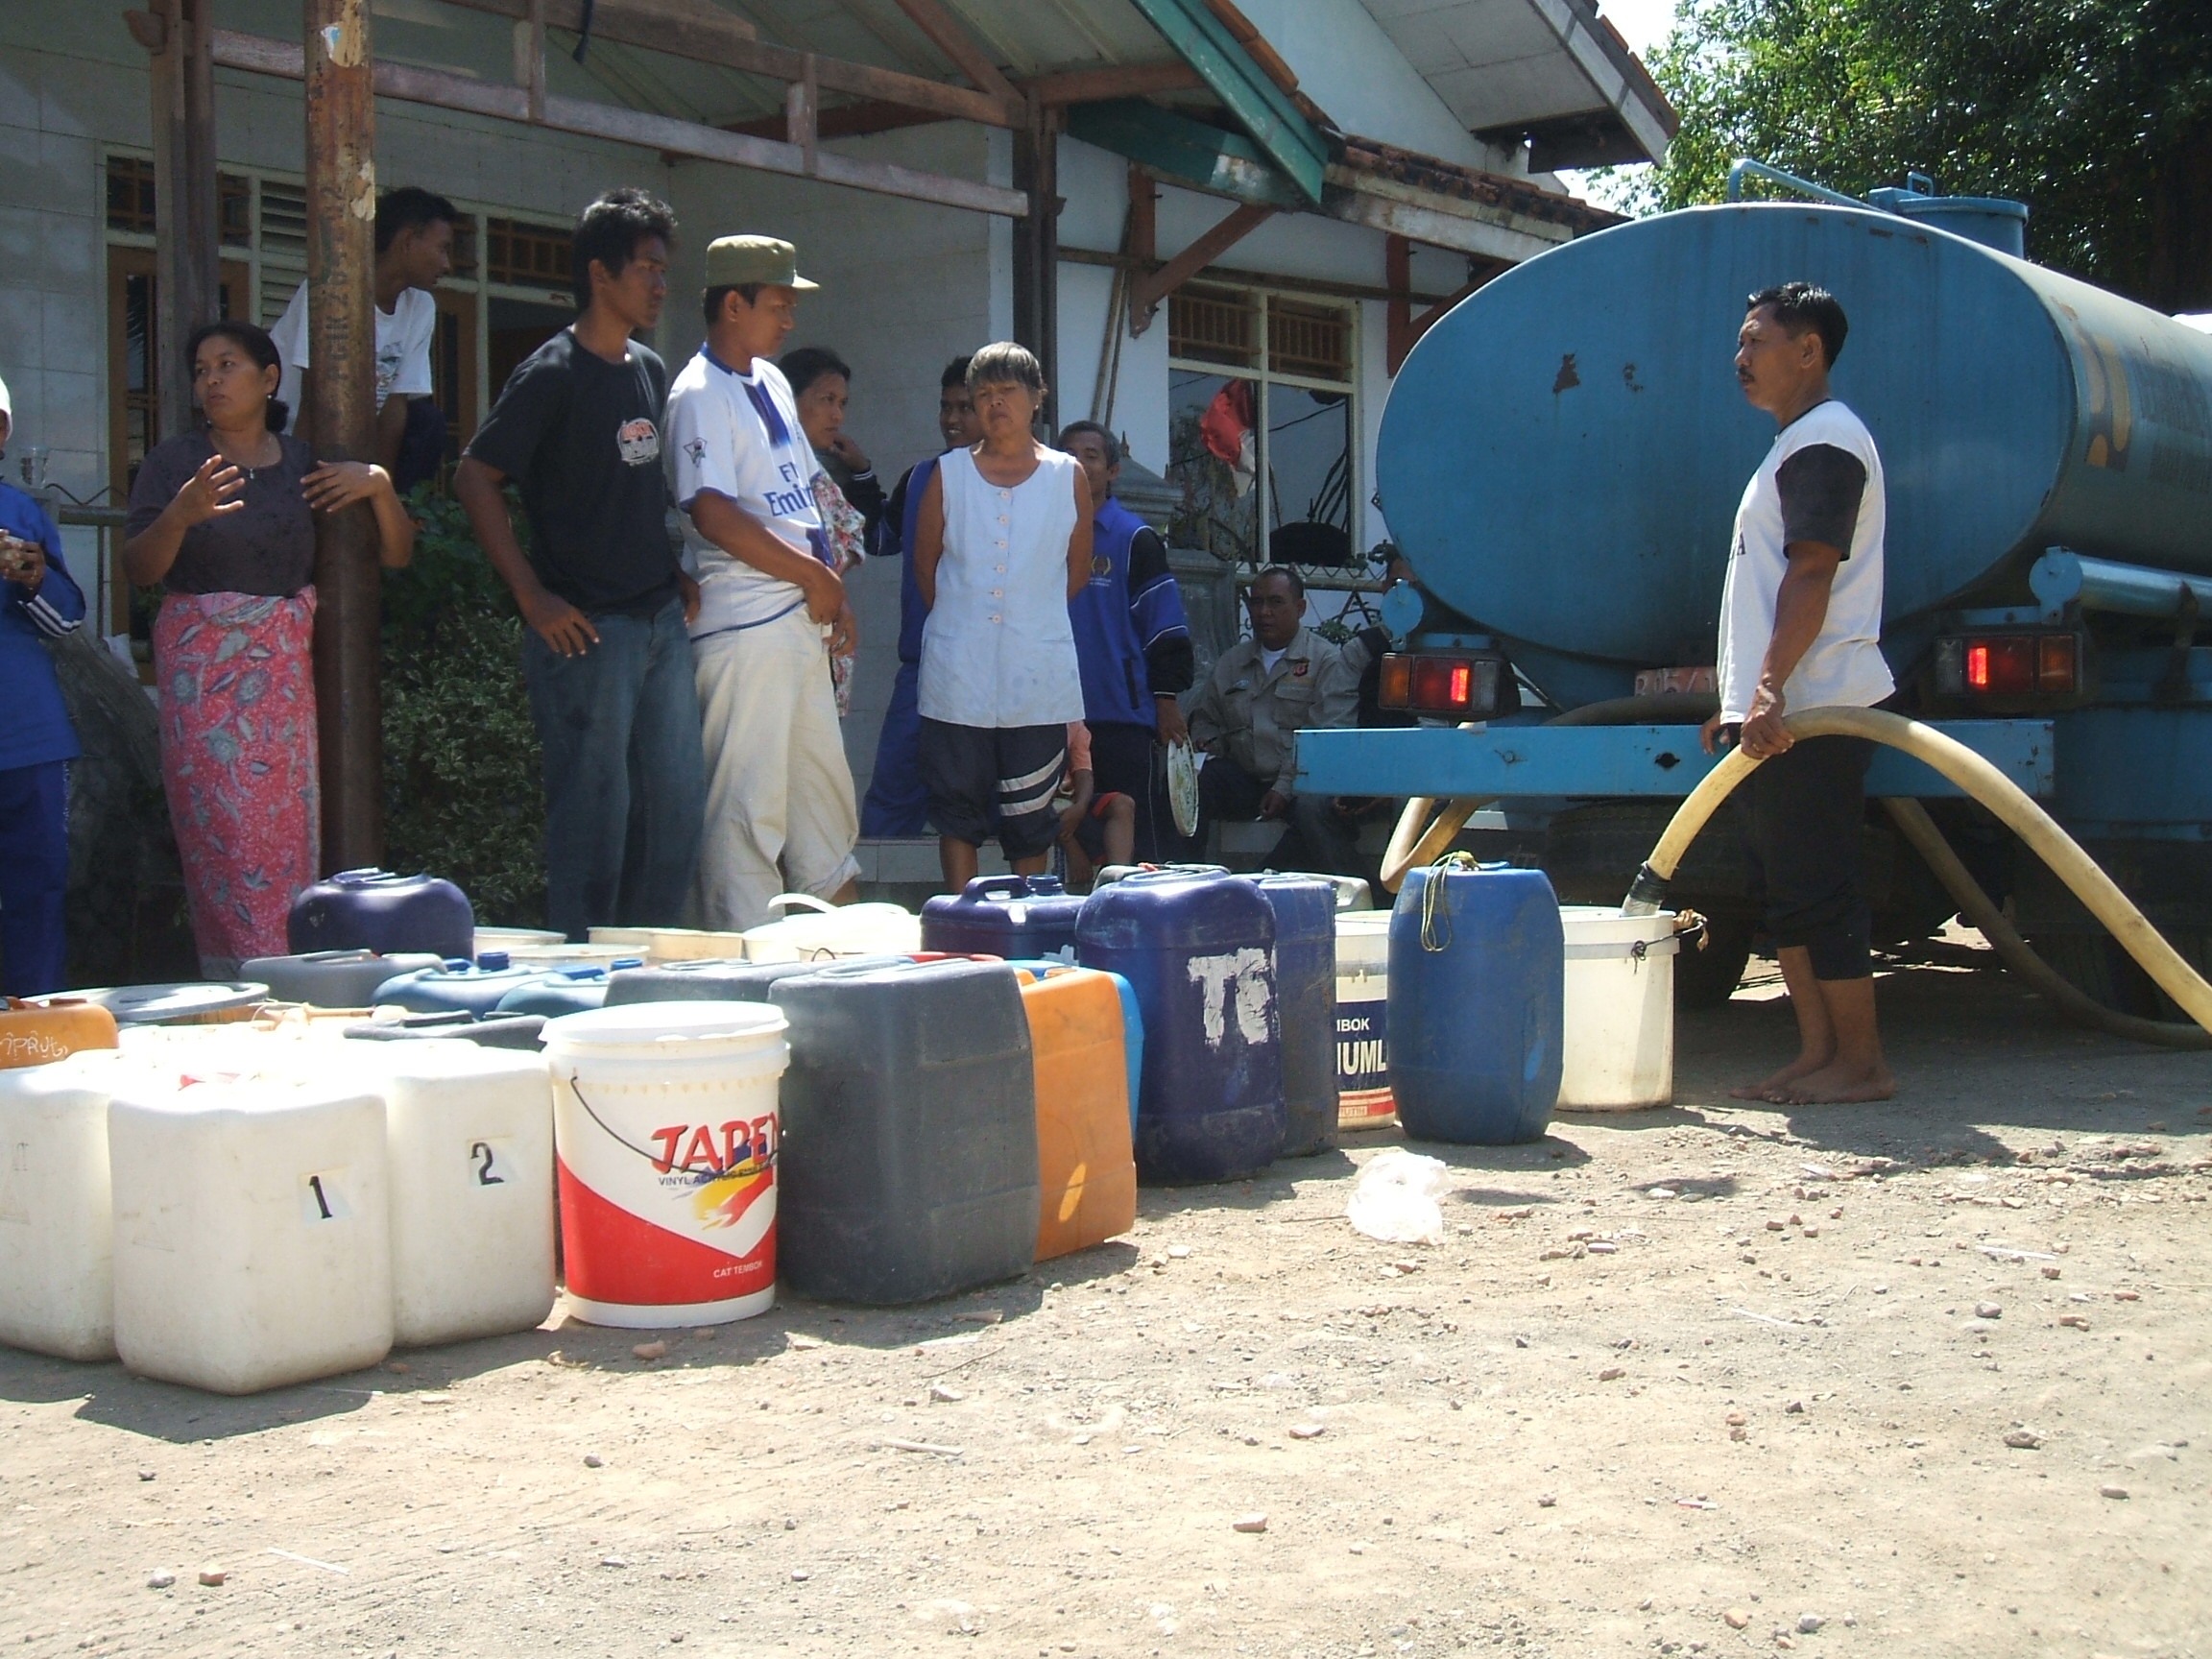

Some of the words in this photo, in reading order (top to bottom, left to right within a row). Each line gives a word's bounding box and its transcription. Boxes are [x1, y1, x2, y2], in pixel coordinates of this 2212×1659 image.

[470, 1142, 504, 1186] 2
[659, 1176, 691, 1187] VINYL
[308, 1175, 333, 1219] 1
[713, 1267, 732, 1278] CAT
